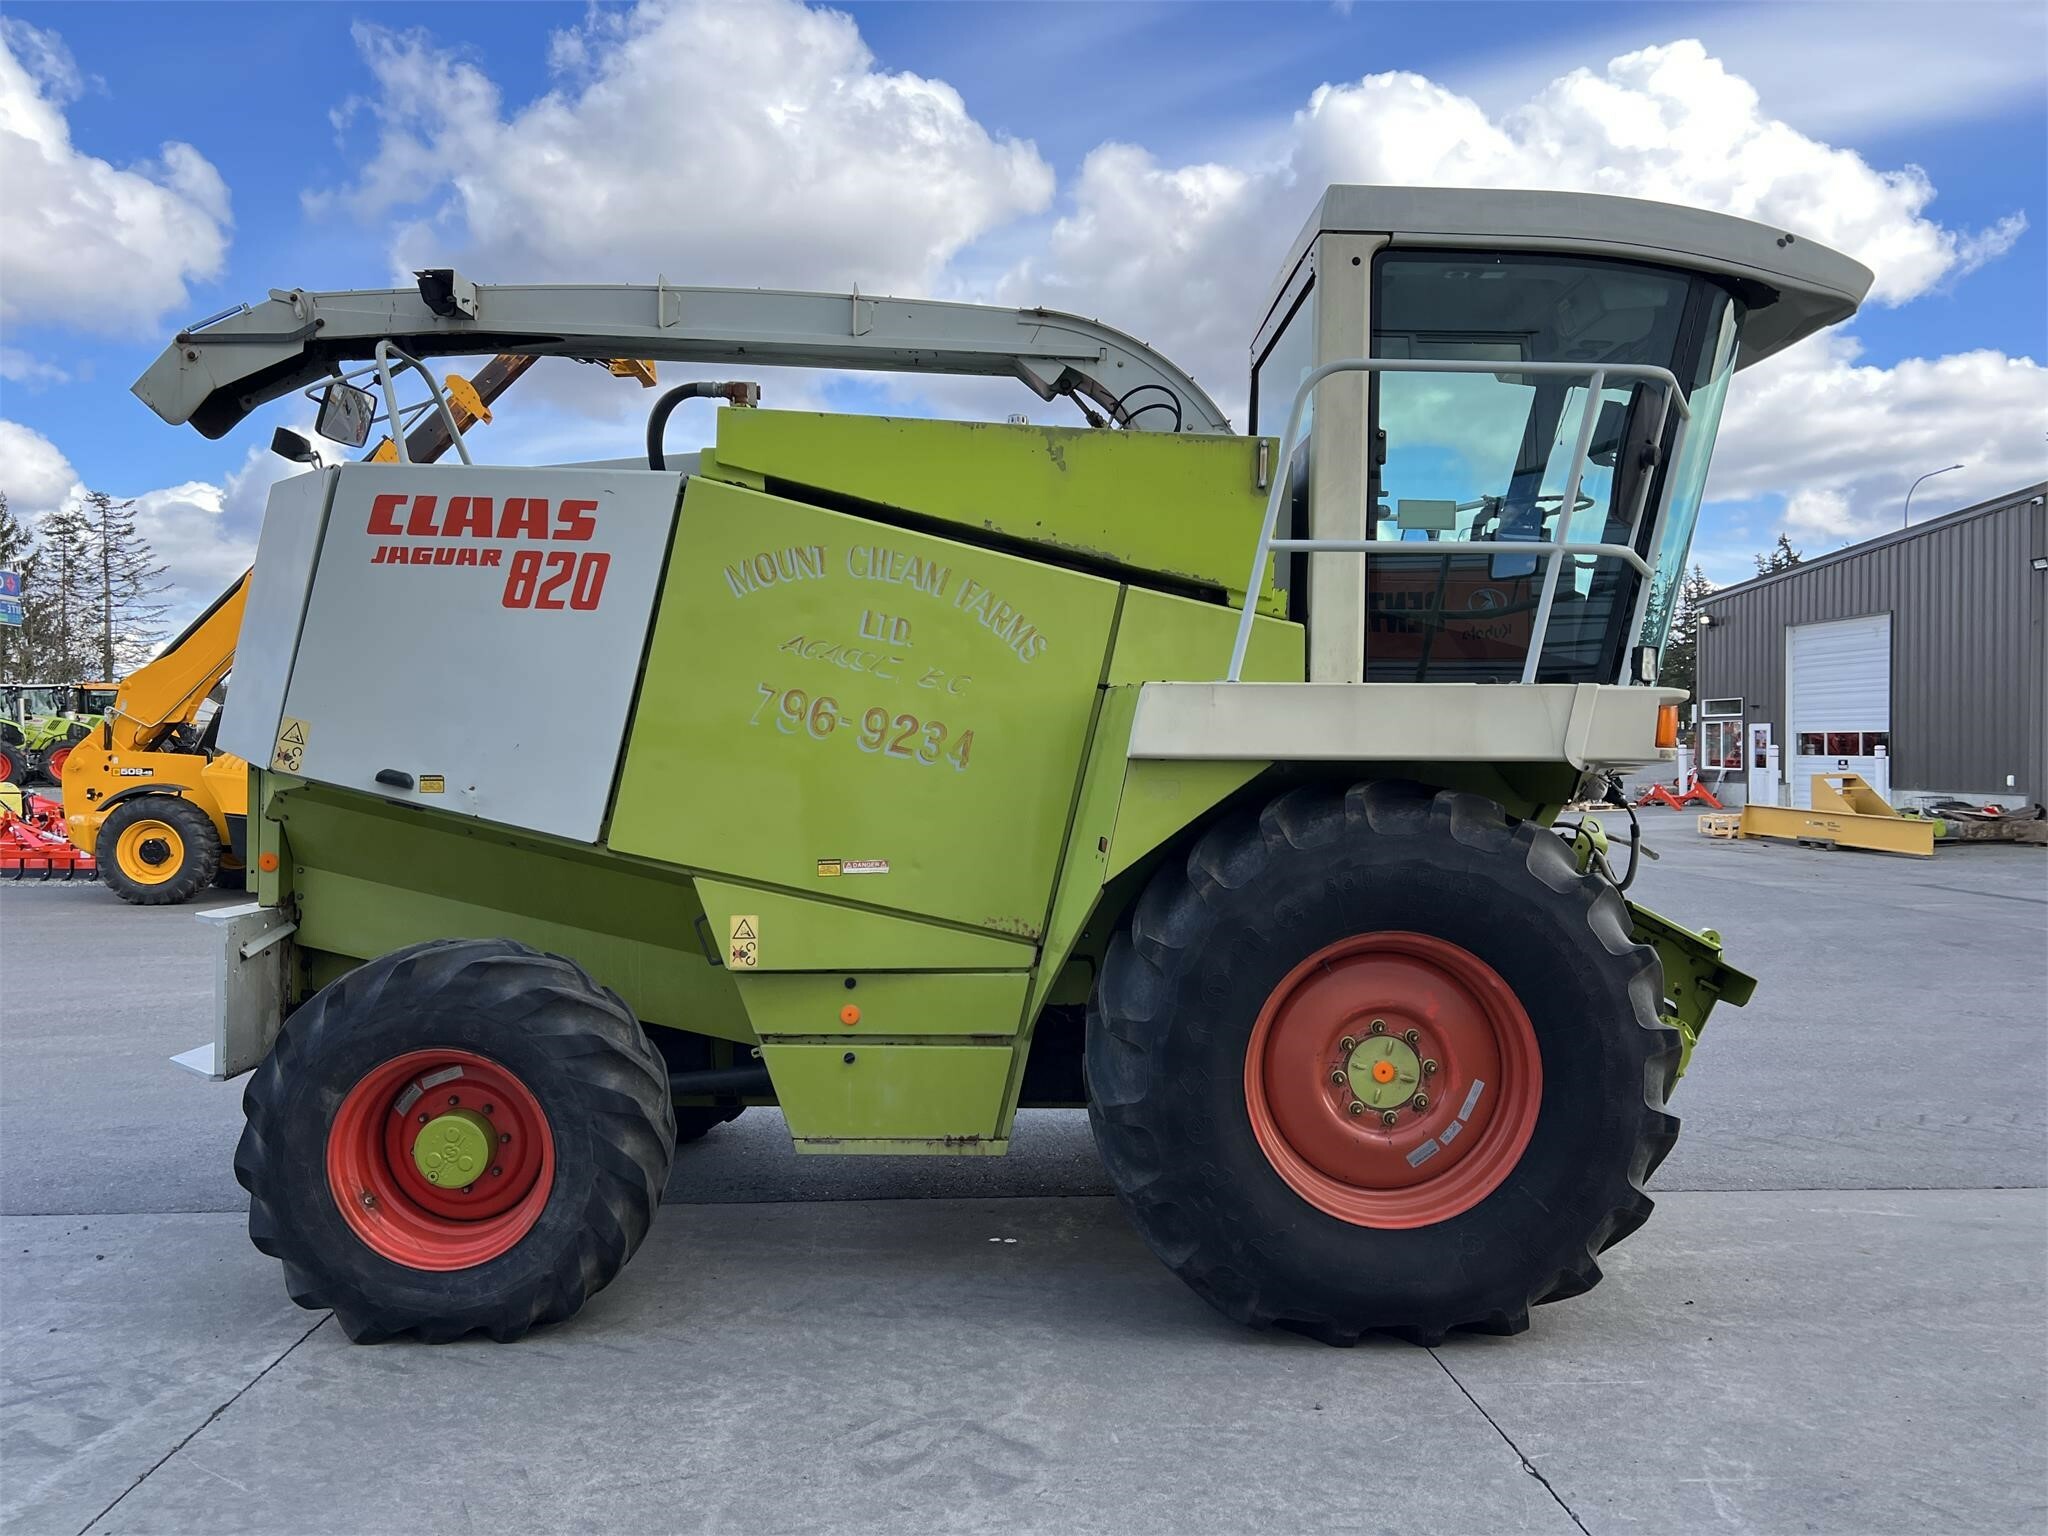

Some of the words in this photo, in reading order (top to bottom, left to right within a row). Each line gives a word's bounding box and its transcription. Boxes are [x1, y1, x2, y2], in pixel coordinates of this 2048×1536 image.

[366, 493, 599, 542] CLAAS
[370, 545, 503, 567] JAGUAR
[501, 550, 612, 611] 820
[722, 544, 828, 600] MOUNT
[953, 577, 1048, 664] FARMS
[748, 682, 976, 772] 796-9234
